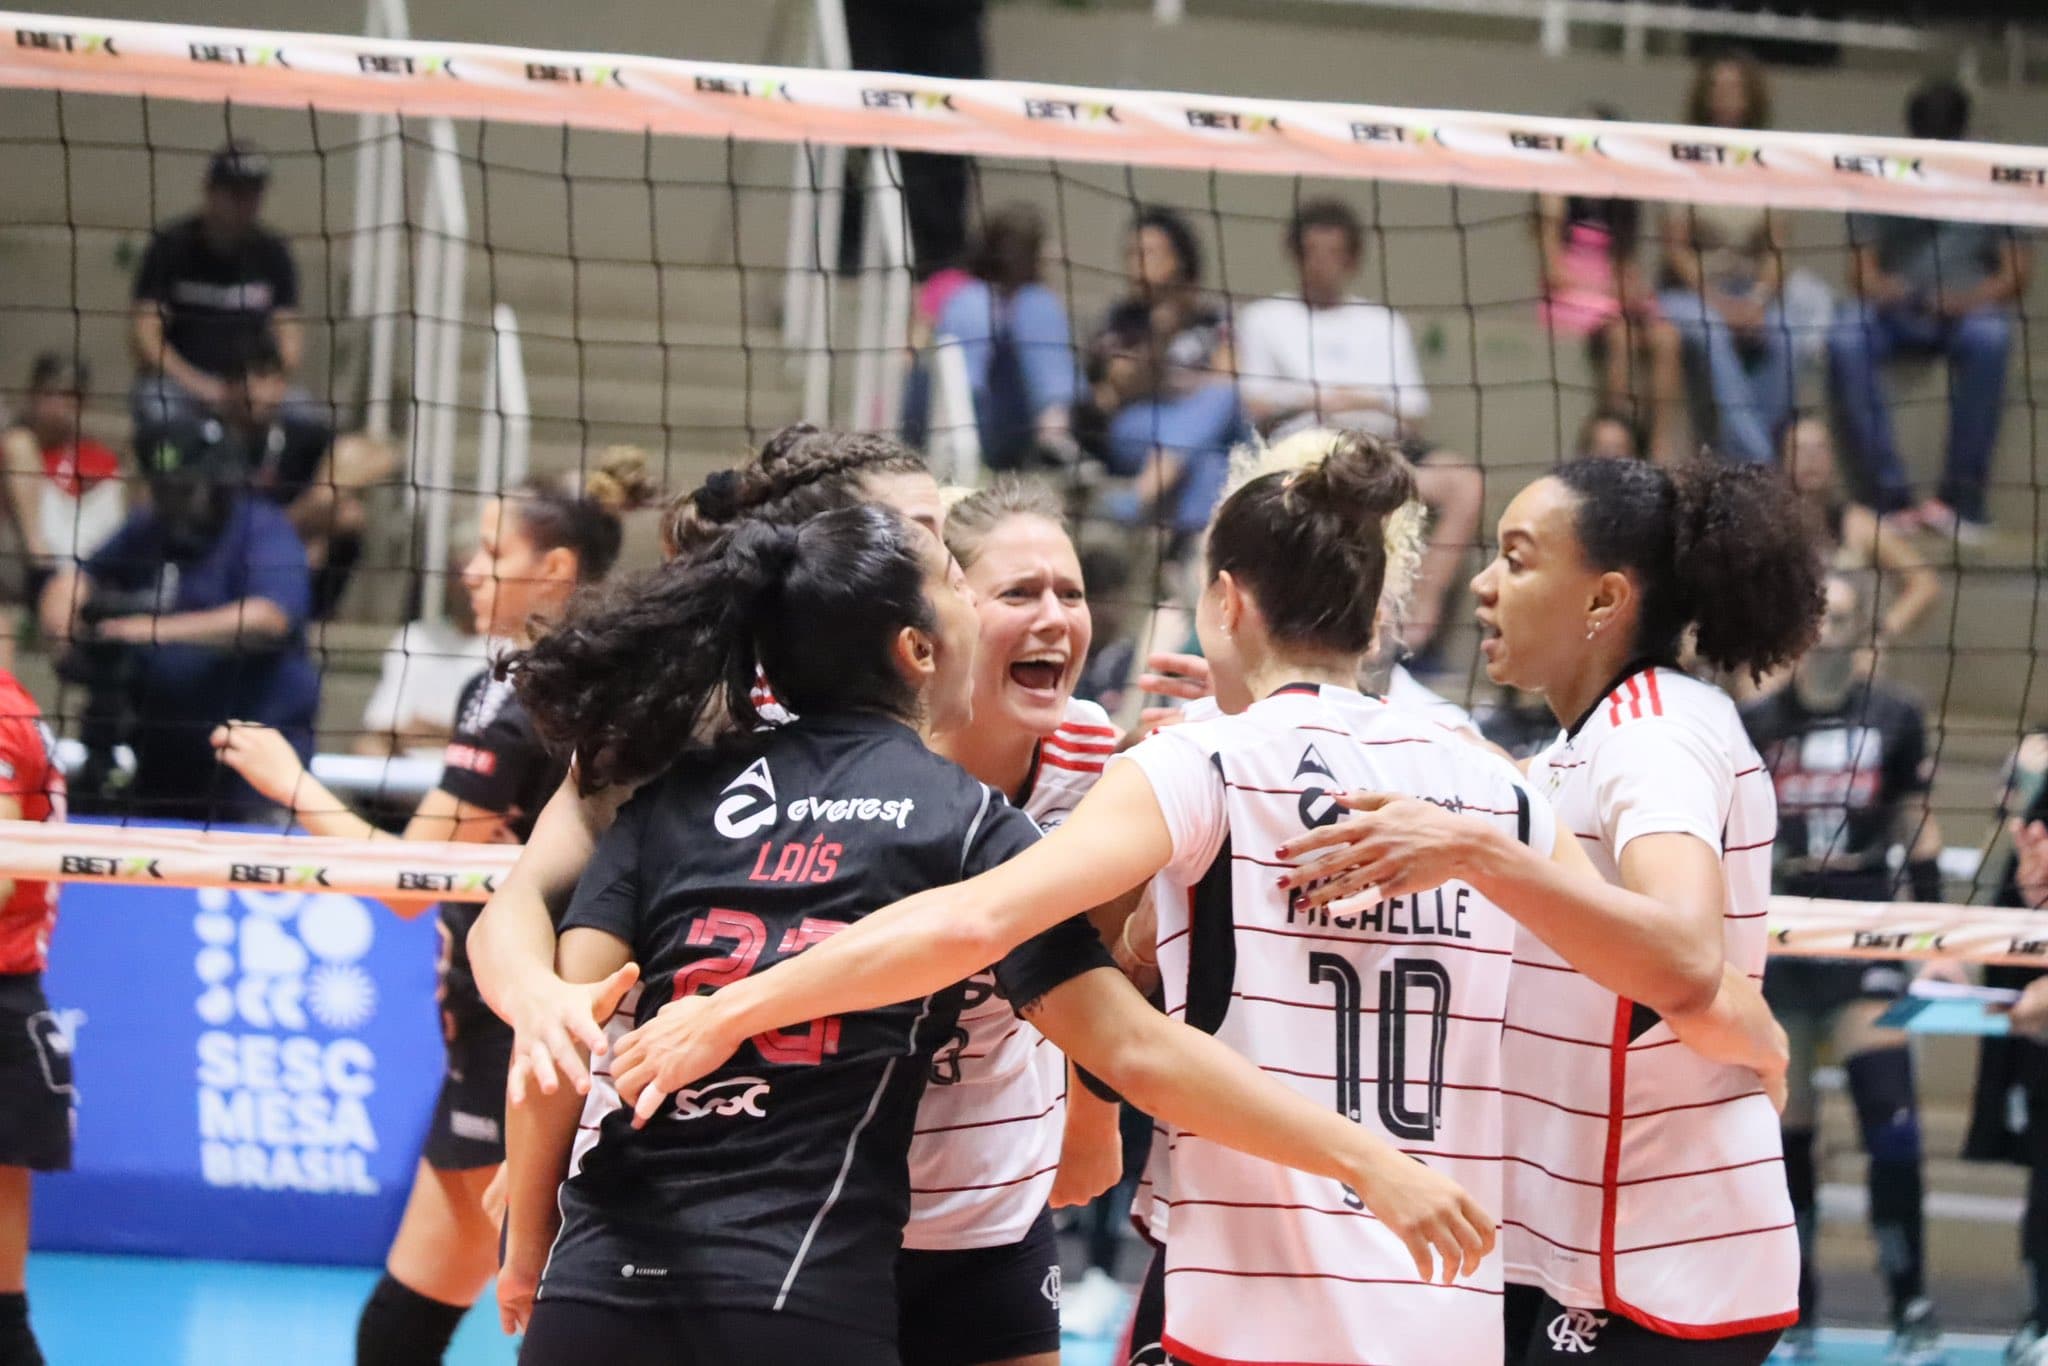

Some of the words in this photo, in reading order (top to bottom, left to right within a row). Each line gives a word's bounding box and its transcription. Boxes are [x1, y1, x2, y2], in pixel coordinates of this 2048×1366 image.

[787, 796, 915, 829] everest
[748, 832, 834, 883] LAÍS
[197, 1030, 376, 1098] SESC
[1308, 951, 1451, 1141] 10
[198, 1088, 379, 1152] MESA
[201, 1141, 380, 1196] BRASIL
